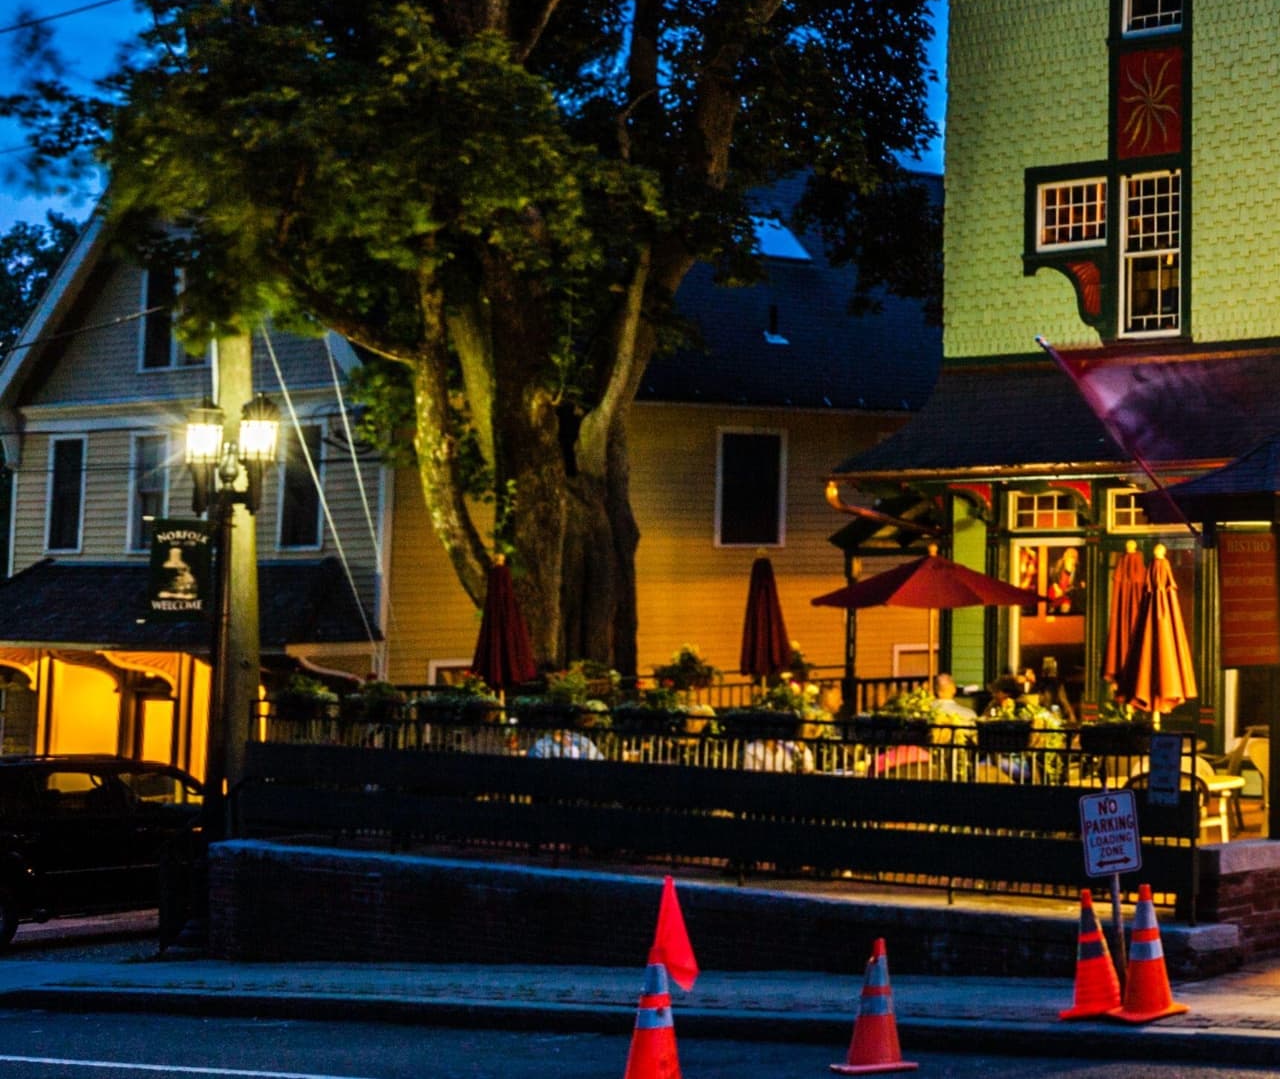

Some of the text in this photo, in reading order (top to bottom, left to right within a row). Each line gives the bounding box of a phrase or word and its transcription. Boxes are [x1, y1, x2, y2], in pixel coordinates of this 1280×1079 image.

[157, 529, 208, 545] NORFOLK
[151, 600, 202, 610] WELCOME
[1097, 799, 1117, 815] NO
[1085, 814, 1134, 834] PARKING
[1090, 831, 1133, 848] LOADING
[1101, 846, 1125, 858] ZONE
